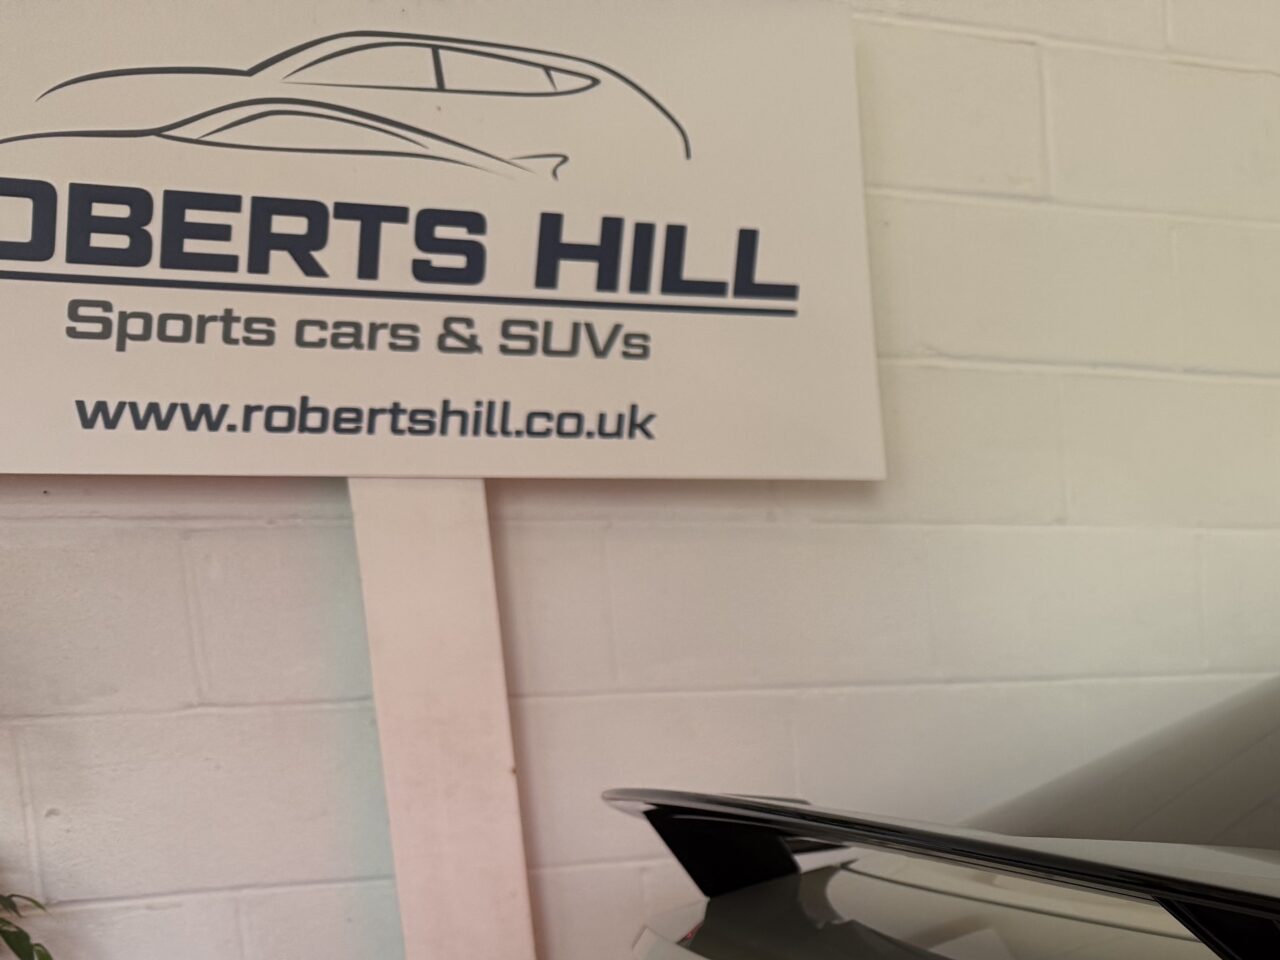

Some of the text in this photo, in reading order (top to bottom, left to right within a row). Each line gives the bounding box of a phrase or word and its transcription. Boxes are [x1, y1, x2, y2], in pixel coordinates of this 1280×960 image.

[533, 211, 800, 301] HILL
[65, 298, 652, 361] Sports cars & SUVs
[75, 396, 657, 440] www.robertshill.co.uk
